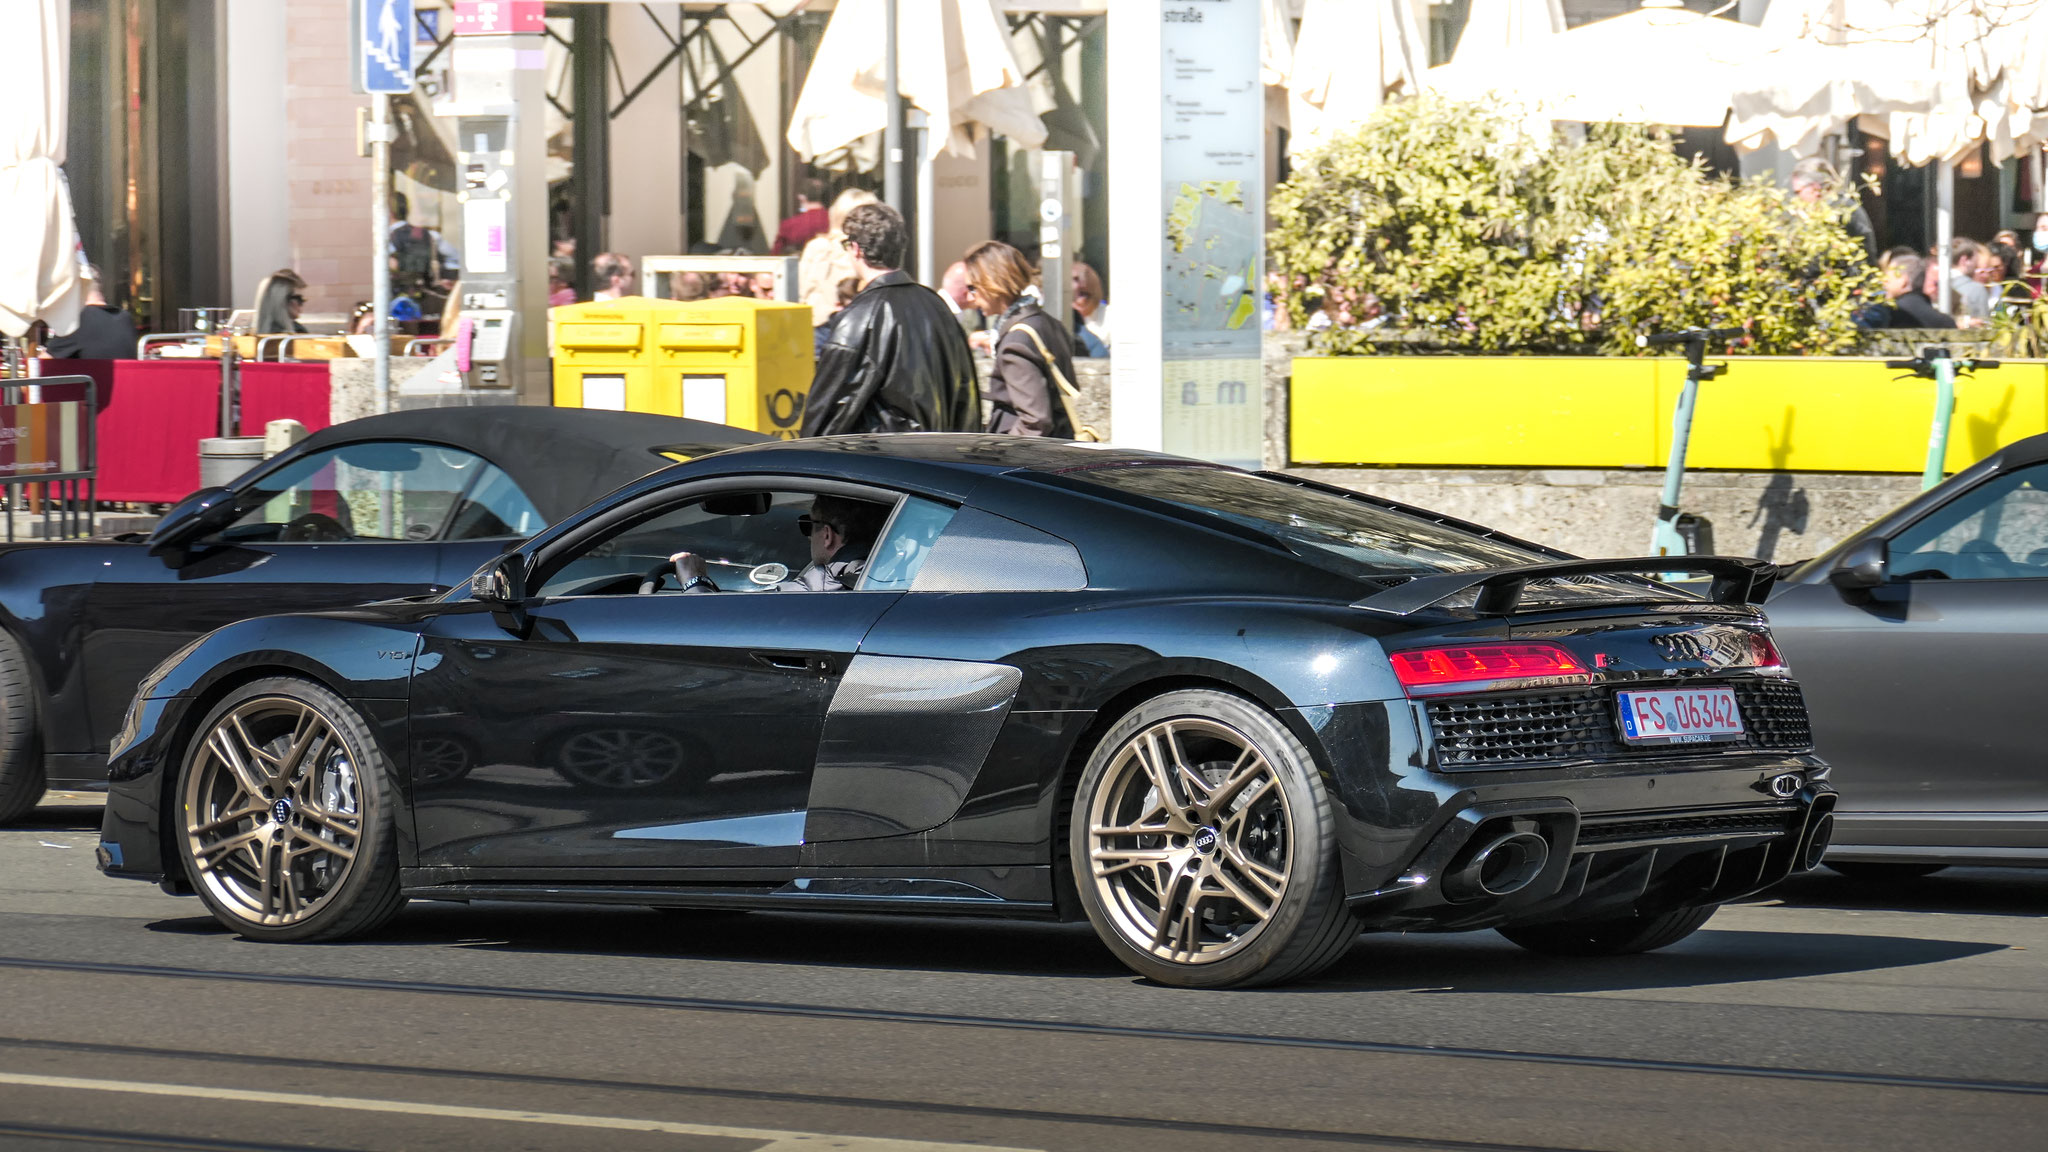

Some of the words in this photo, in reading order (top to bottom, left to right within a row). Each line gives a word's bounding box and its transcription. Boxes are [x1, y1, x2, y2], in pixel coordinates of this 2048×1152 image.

[1634, 696, 1666, 731] FS
[1674, 694, 1738, 729] 06342
[1625, 720, 1633, 731] D
